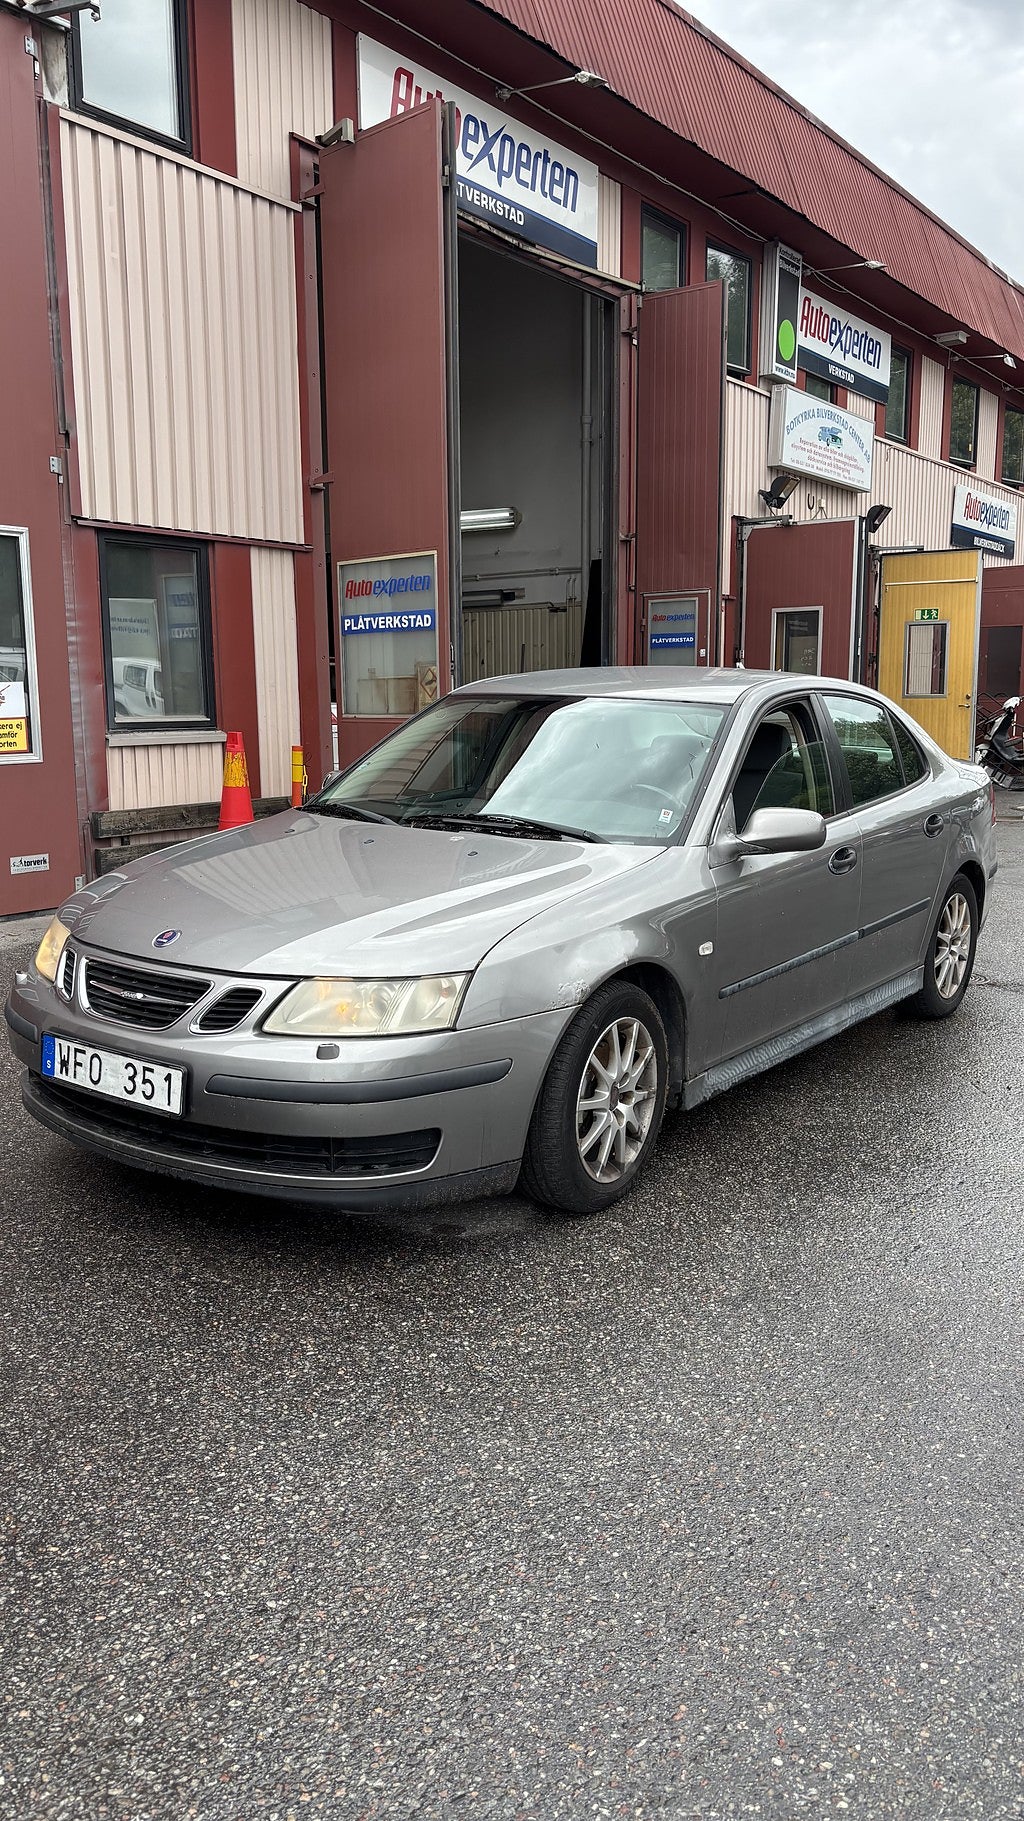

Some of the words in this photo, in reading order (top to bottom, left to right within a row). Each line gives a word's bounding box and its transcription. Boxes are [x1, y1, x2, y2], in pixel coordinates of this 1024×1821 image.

[800, 296, 882, 369] Autoexperten
[828, 363, 855, 384] VERKSTAD
[786, 408, 816, 435] BOTKYRKA
[816, 408, 849, 430] BILVERKSTAD
[848, 426, 865, 452] CENTER
[963, 492, 1010, 530] Autoexperten
[344, 614, 432, 631] PLÅTVERKSTAD
[16, 721, 22, 730] ej
[46, 1059, 52, 1068] S
[58, 1043, 102, 1085] WFO
[123, 1062, 172, 1107] 351
